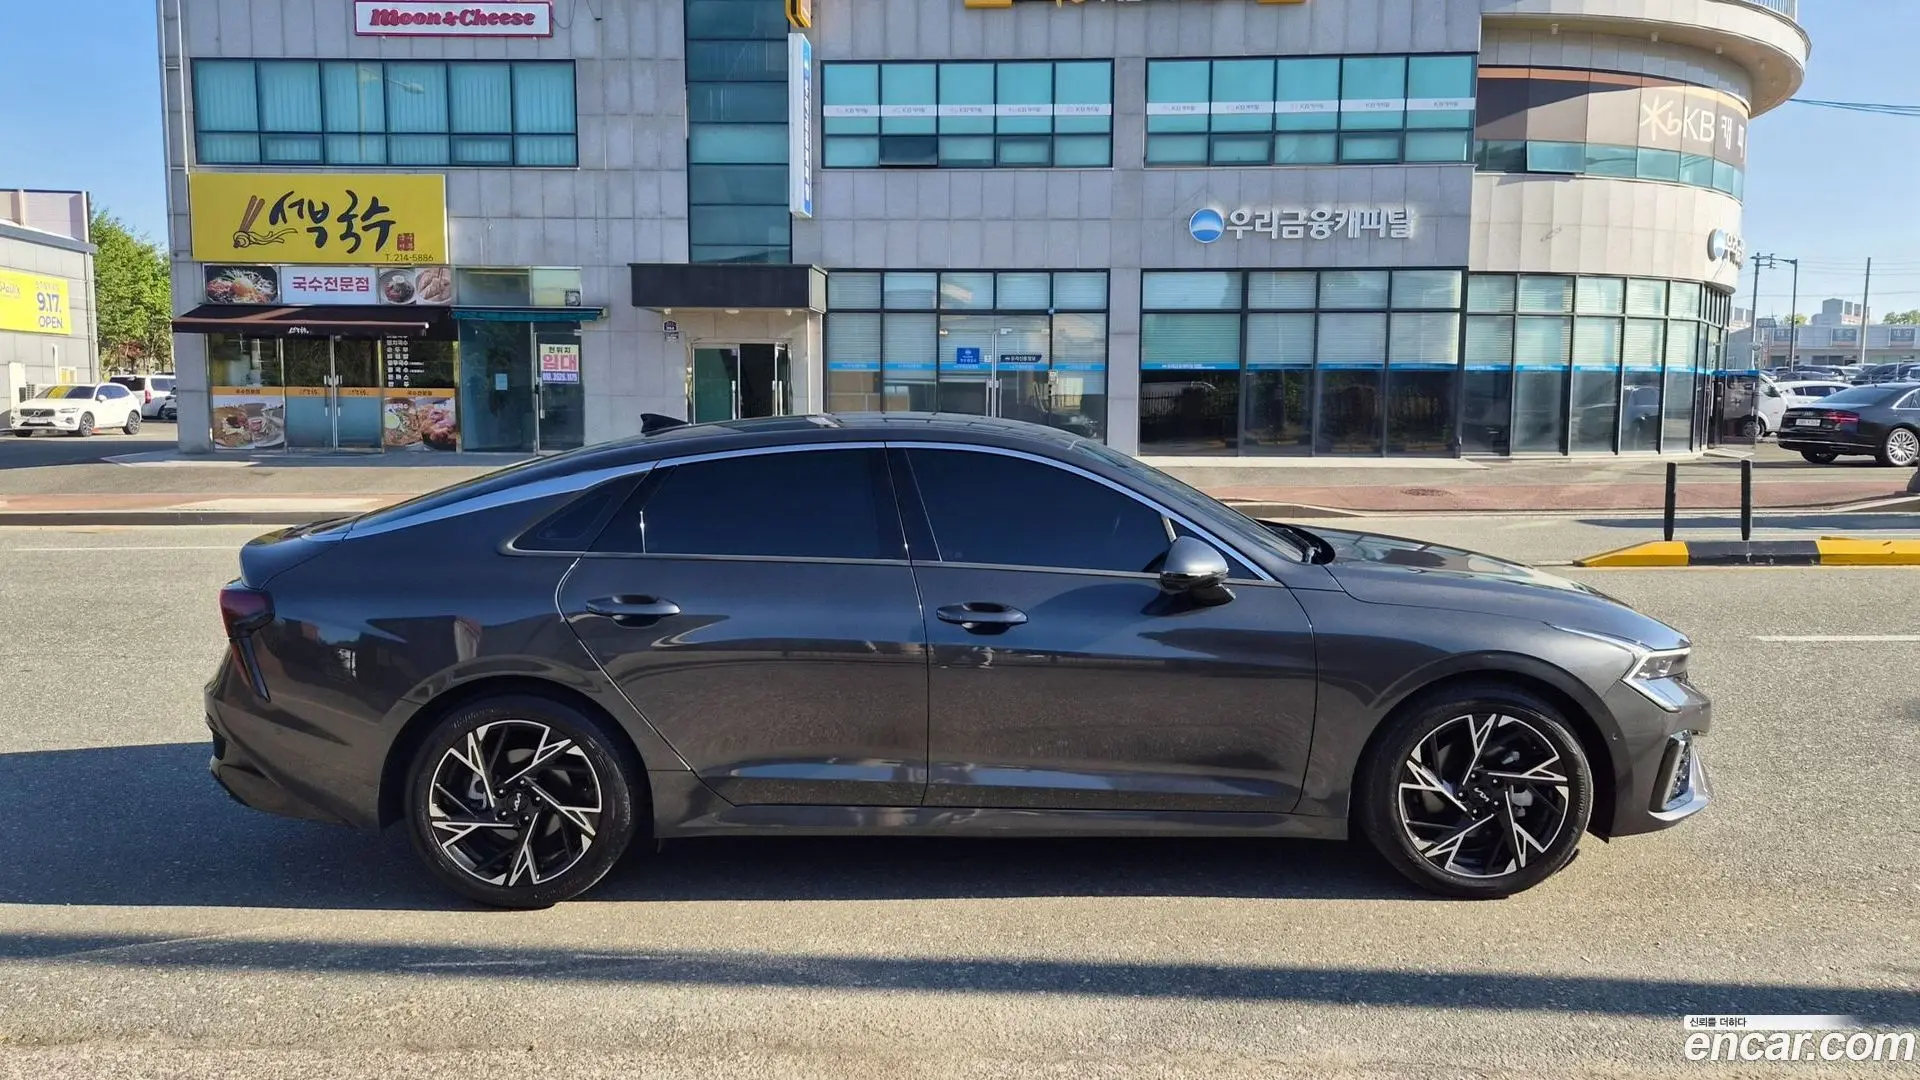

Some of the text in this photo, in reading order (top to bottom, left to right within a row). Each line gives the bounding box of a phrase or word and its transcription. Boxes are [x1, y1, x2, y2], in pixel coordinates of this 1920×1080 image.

[369, 8, 537, 27] Moon&Cheese
[1683, 106, 1715, 142] KB
[1226, 207, 1415, 240] 우리금융캐피탈
[291, 275, 370, 292] 국수전문점
[39, 315, 63, 329] OPEN
[543, 354, 577, 370] 임대
